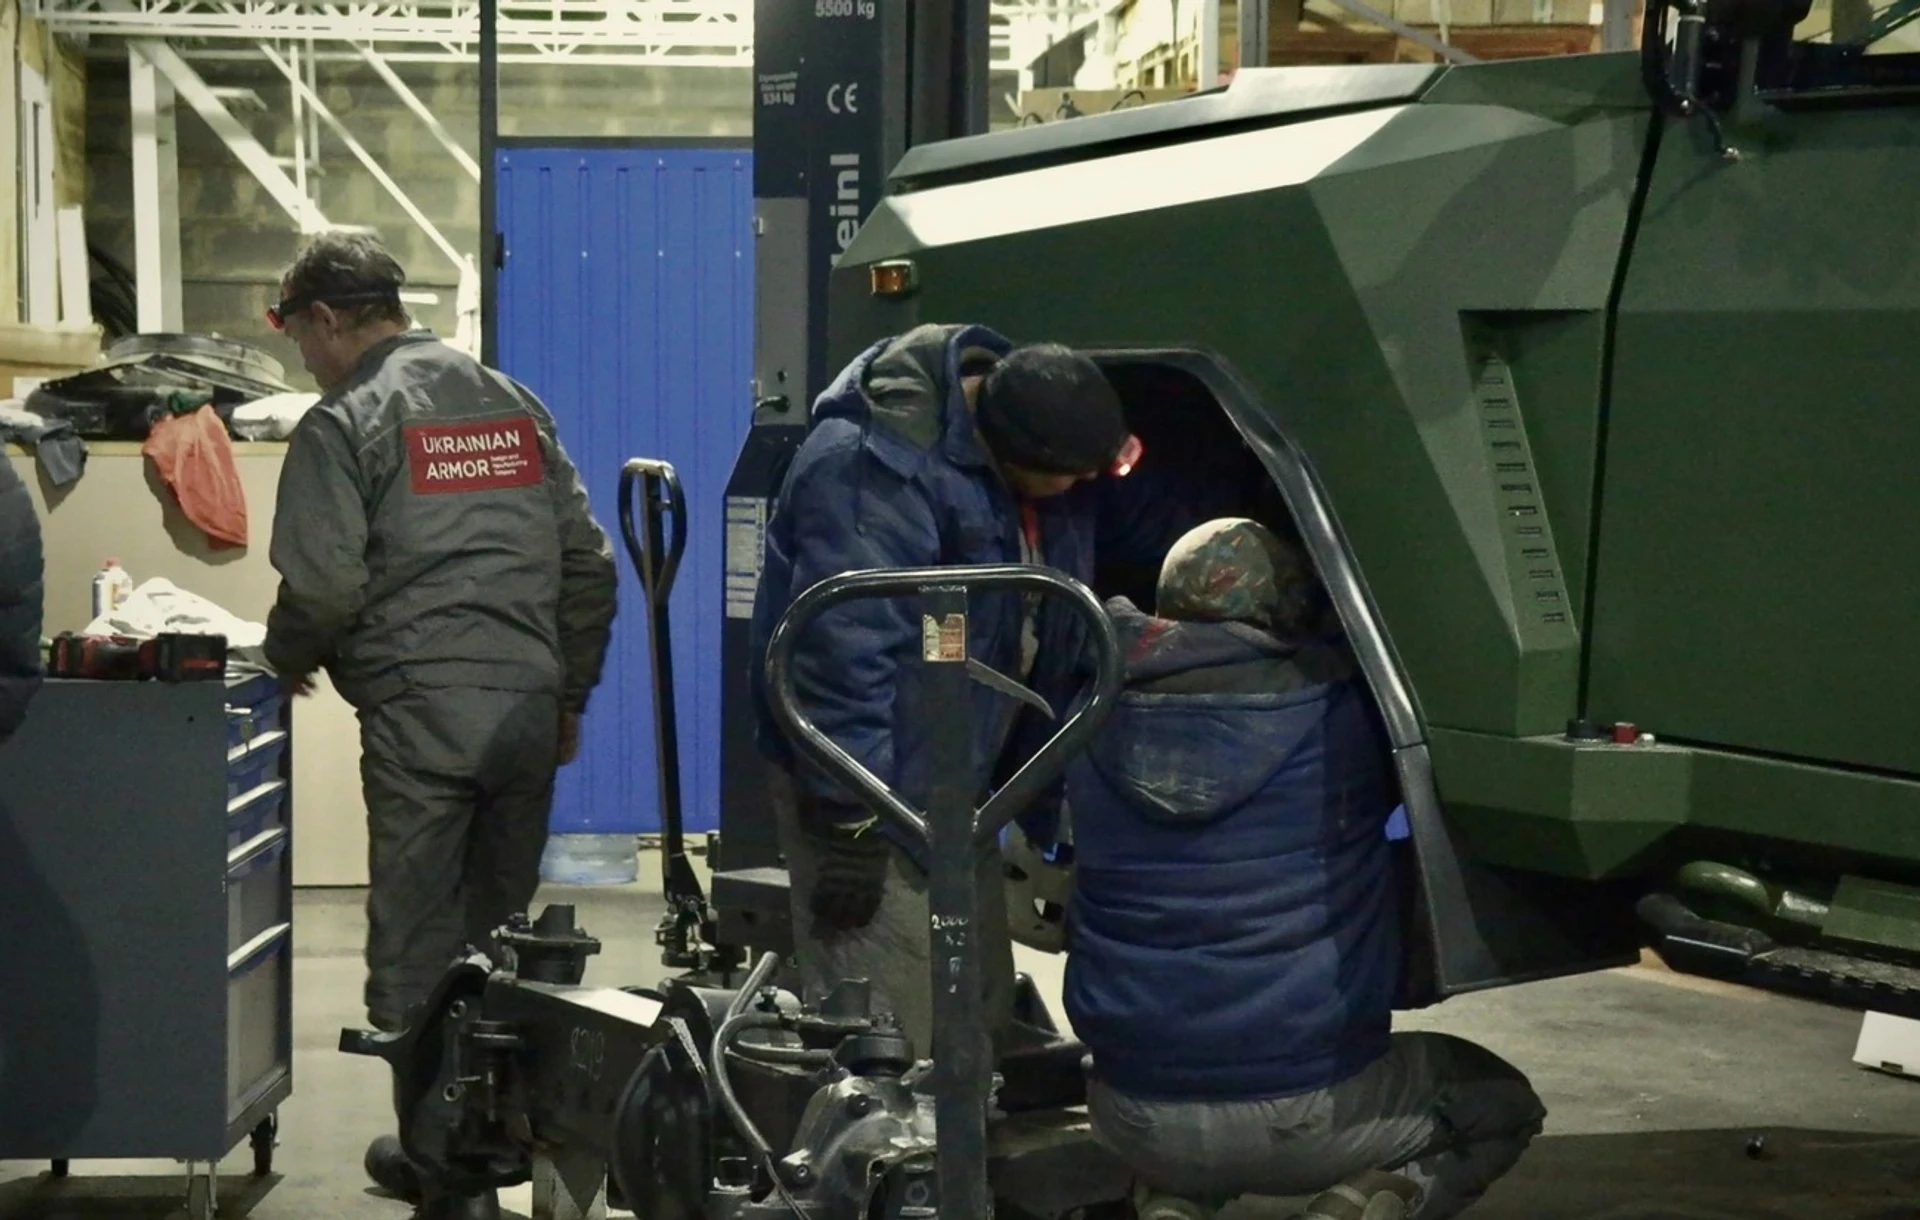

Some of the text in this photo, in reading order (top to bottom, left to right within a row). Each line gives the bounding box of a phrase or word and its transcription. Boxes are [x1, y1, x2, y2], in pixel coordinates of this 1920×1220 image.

[827, 83, 858, 114] CE
[422, 429, 520, 454] UKRAINIAN
[426, 459, 490, 480] ARMOR
